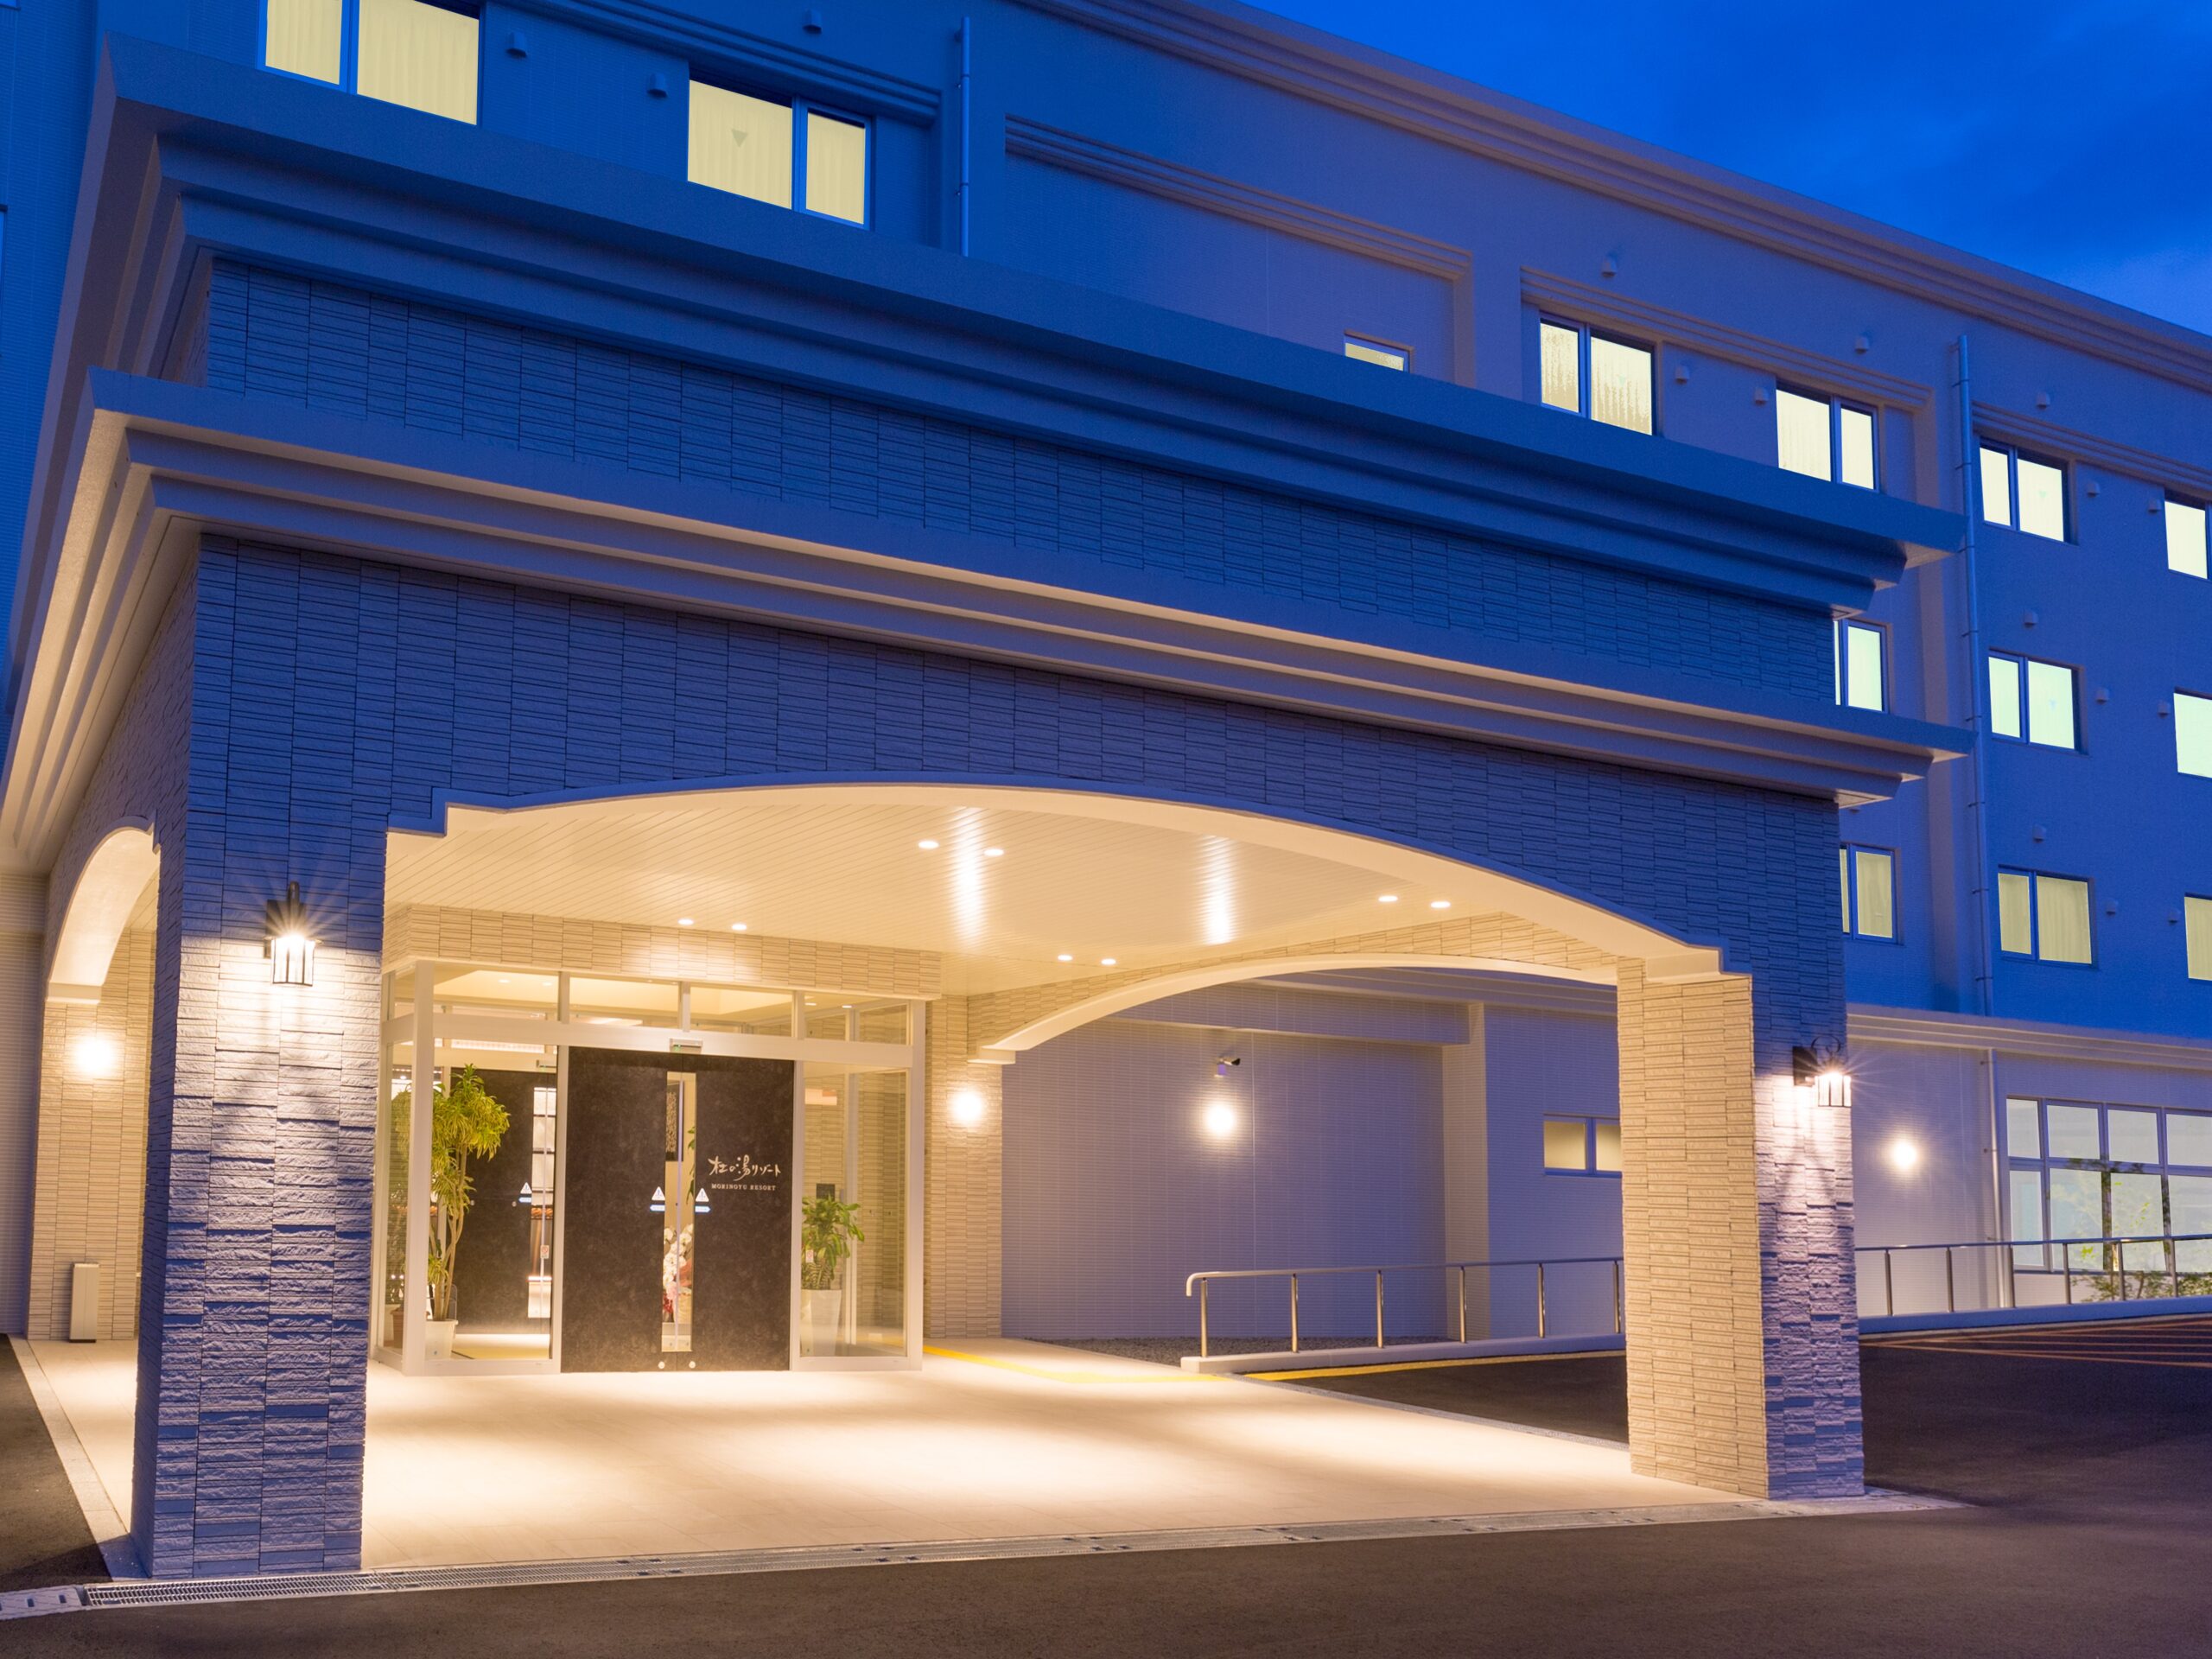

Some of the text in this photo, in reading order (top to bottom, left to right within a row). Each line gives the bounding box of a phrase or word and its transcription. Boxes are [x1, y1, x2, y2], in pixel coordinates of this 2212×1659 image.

[708, 1154, 781, 1181] 杜の湯リゾート
